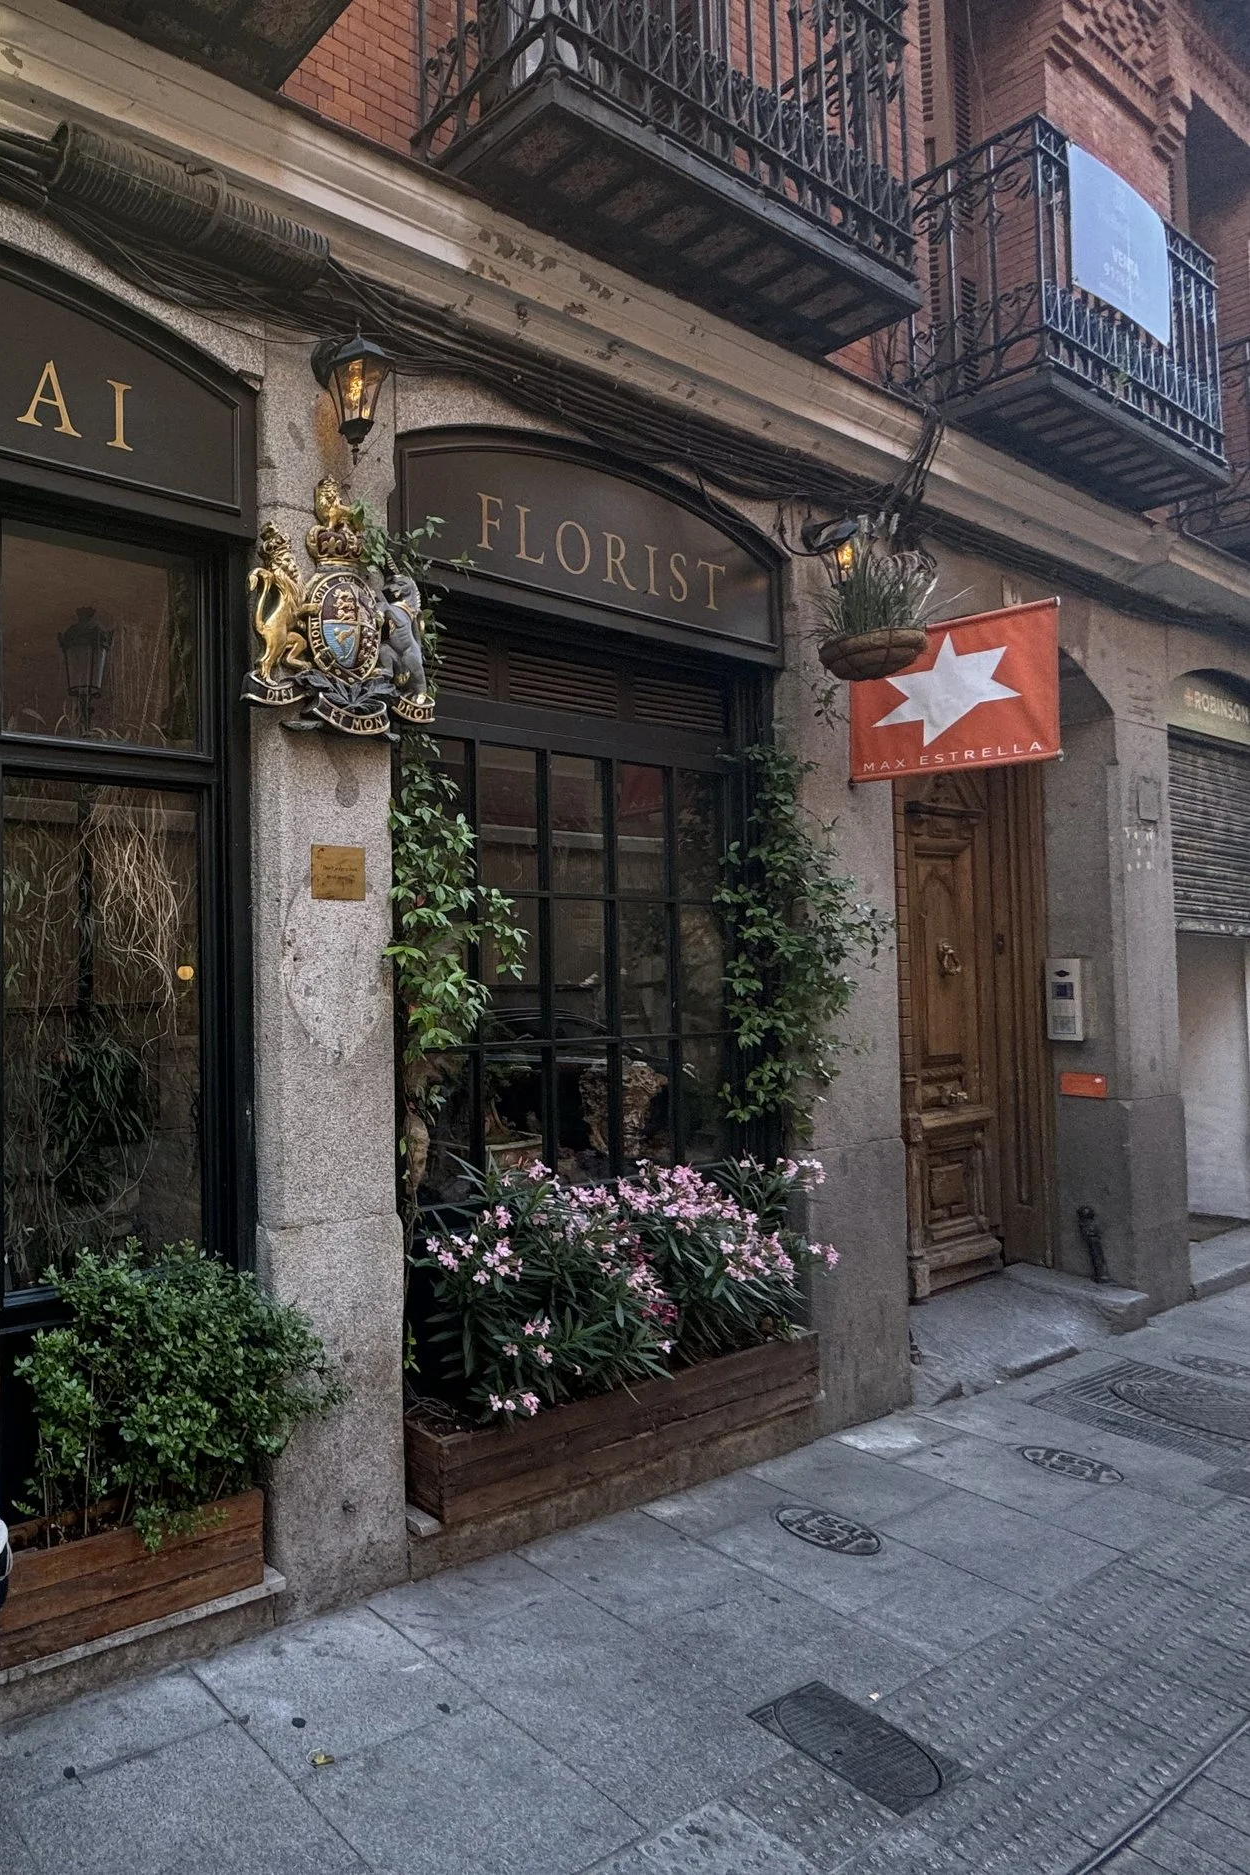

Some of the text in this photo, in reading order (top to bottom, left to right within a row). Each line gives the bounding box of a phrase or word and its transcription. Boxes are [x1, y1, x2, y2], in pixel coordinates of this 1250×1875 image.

[476, 492, 726, 611] FLORIST
[351, 716, 384, 731] MON
[1194, 690, 1250, 725] ROBINSON
[863, 741, 1043, 772] MAX ESTRELLA
